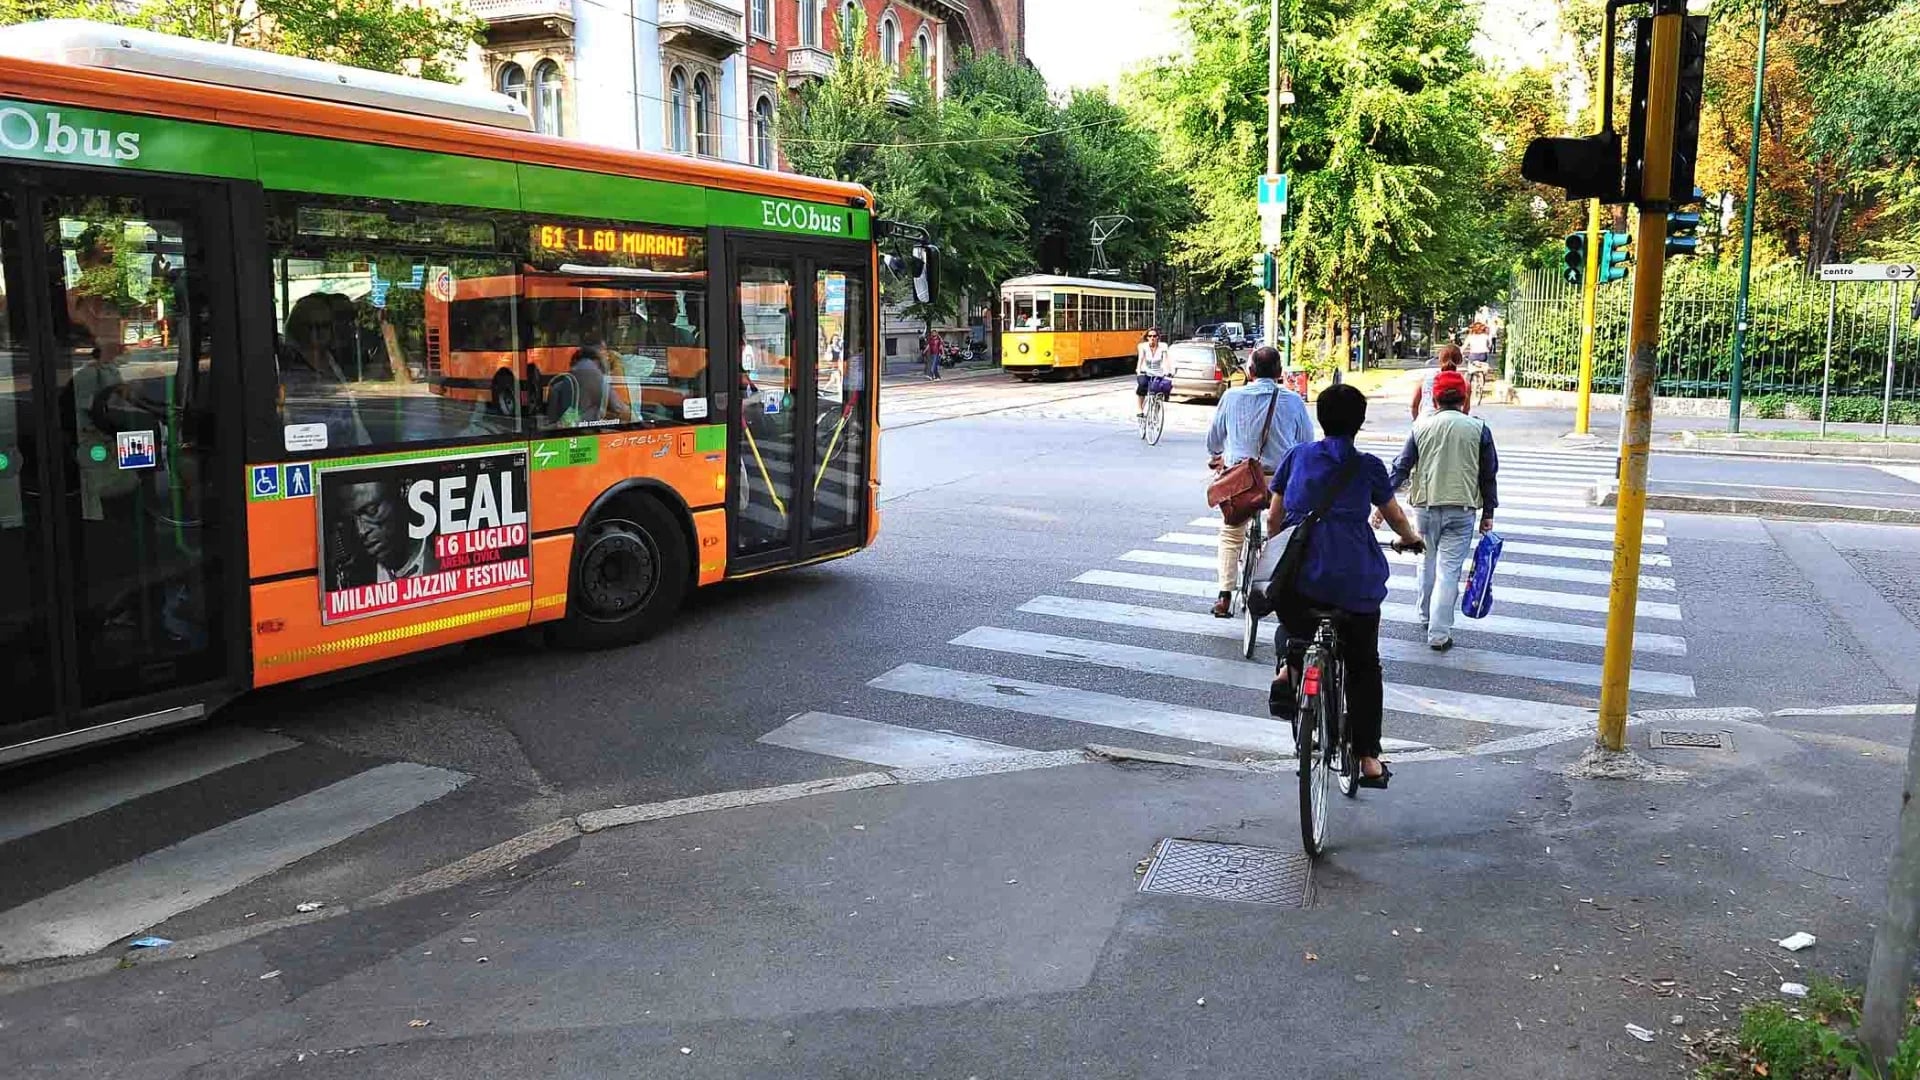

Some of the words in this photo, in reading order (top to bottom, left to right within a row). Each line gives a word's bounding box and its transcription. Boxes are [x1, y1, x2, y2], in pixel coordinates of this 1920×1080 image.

[761, 200, 842, 233] ECObus
[541, 225, 564, 248] 61
[578, 228, 615, 251] L.GO
[622, 231, 685, 256] MURANI
[1823, 268, 1854, 276] centro
[408, 471, 527, 539] SEAL
[437, 535, 460, 558] 16
[465, 525, 525, 554] LUGLIO
[440, 553, 471, 570] ARENA
[473, 549, 501, 564] CIVICA
[331, 582, 398, 614] MILANO
[403, 570, 461, 601] JAZZIN'
[466, 558, 528, 589] FESTIVAL
